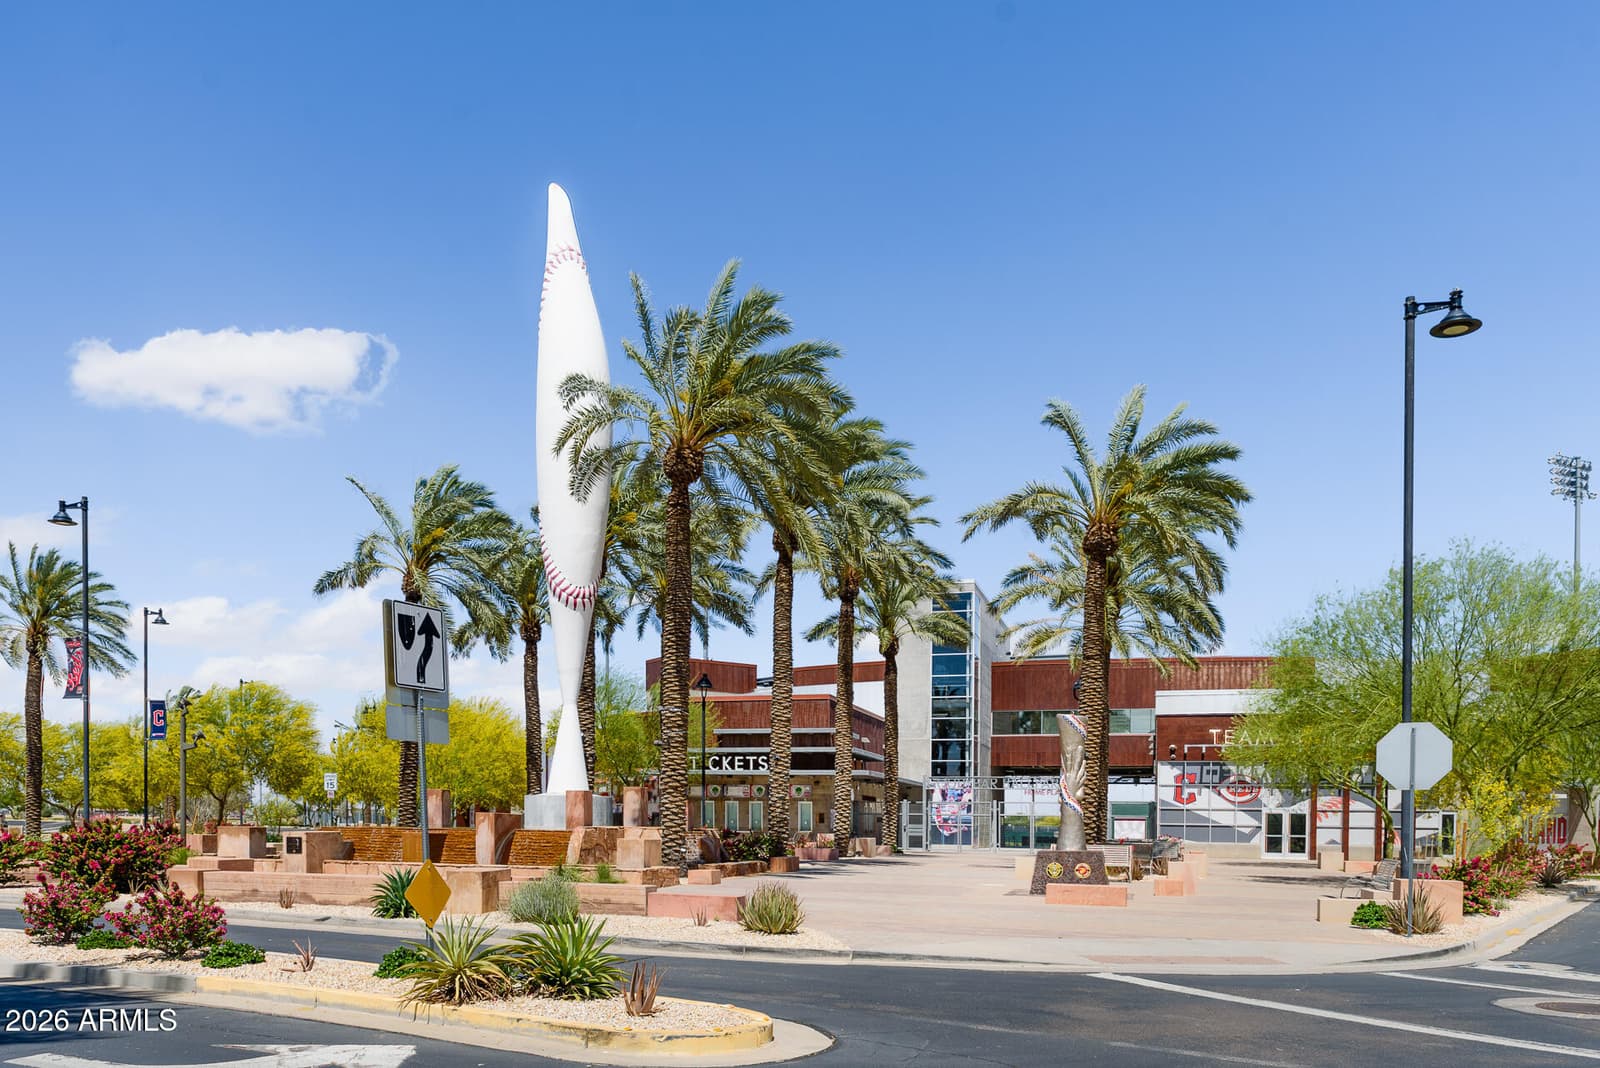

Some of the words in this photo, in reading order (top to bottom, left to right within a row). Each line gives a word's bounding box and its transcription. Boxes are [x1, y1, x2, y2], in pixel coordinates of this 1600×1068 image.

[153, 709, 164, 727] C
[1208, 729, 1274, 745] TEAM
[689, 756, 768, 770] TCKETS
[1173, 773, 1197, 805] C
